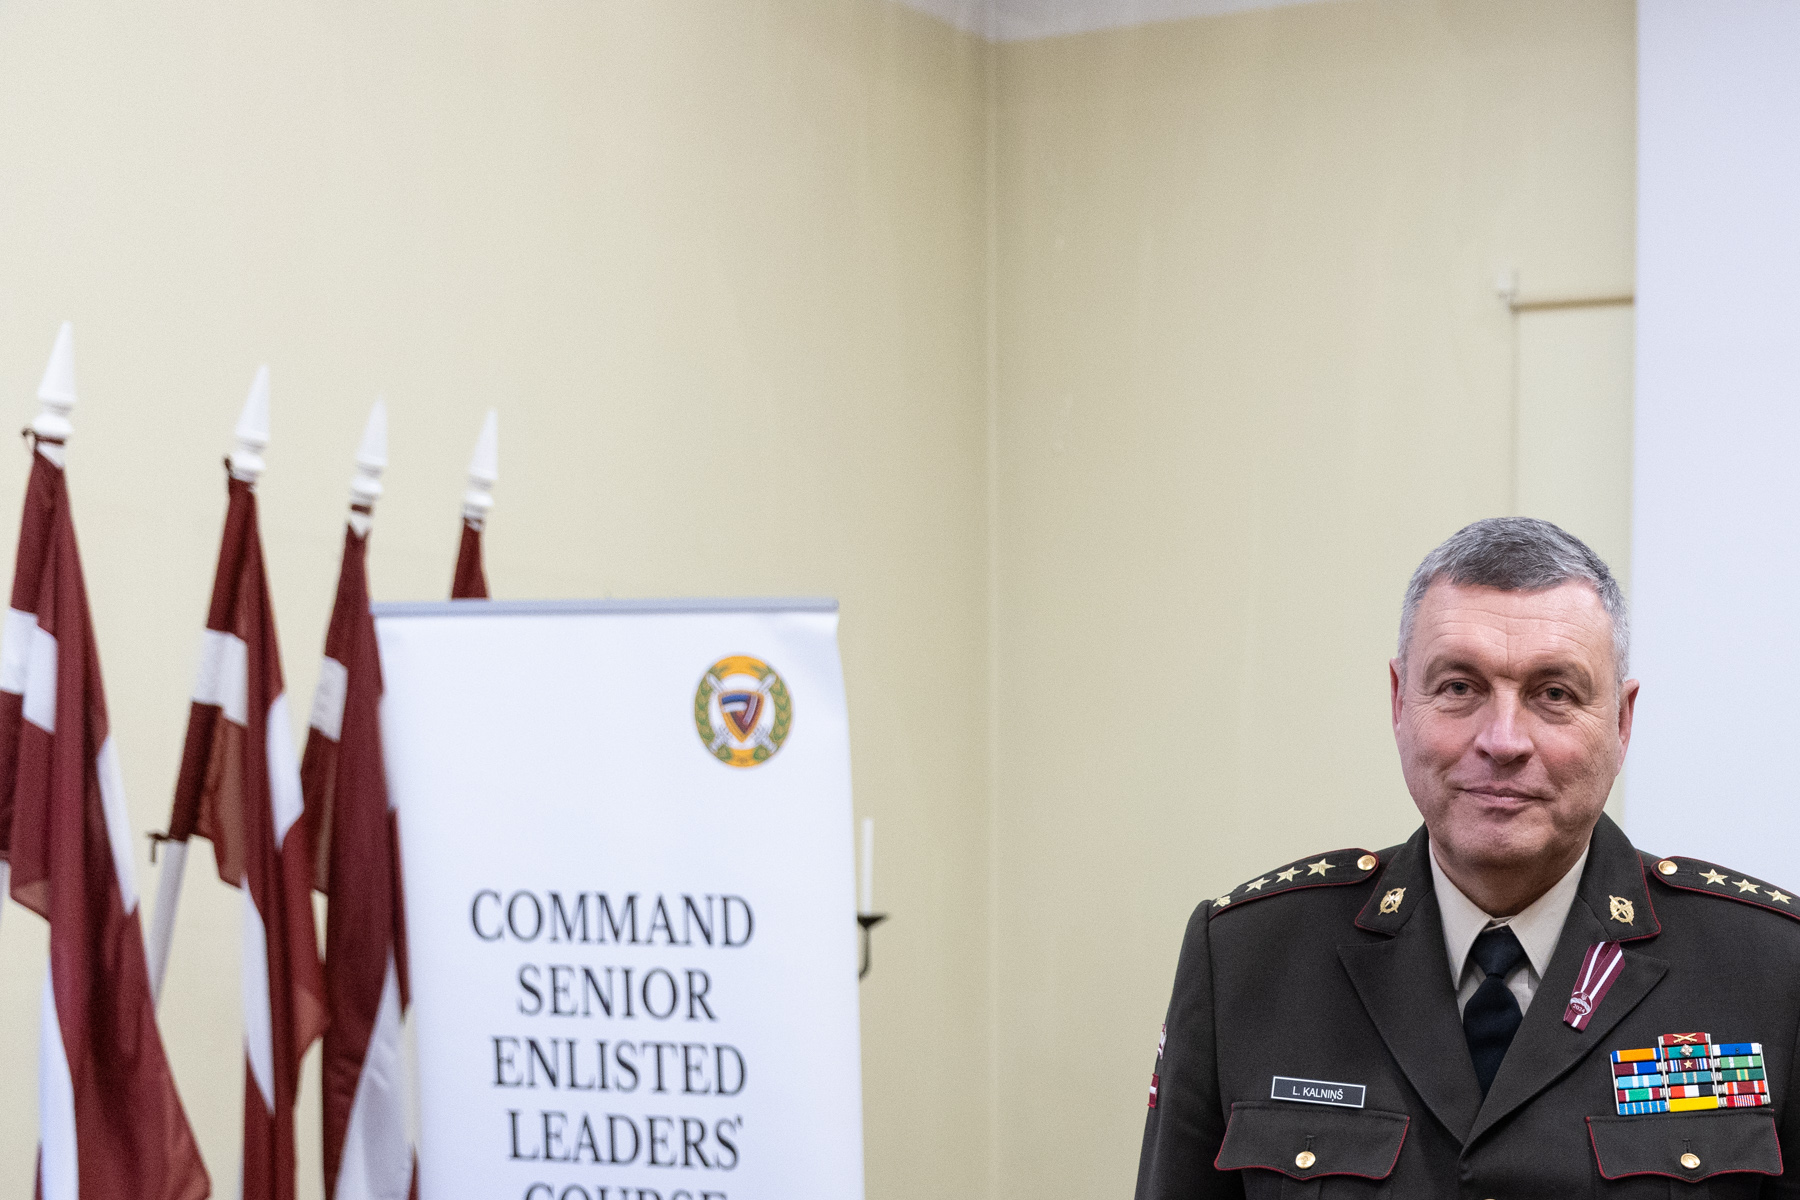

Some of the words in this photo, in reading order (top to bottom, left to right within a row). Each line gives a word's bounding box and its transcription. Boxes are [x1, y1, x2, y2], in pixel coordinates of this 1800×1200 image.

[471, 889, 756, 948] COMMAND
[516, 962, 718, 1021] SENIOR
[491, 1034, 748, 1097] ENLISTED
[1292, 1086, 1301, 1096] L.
[1303, 1086, 1344, 1102] KALNIŅŠ
[507, 1108, 743, 1171] LEADERS'
